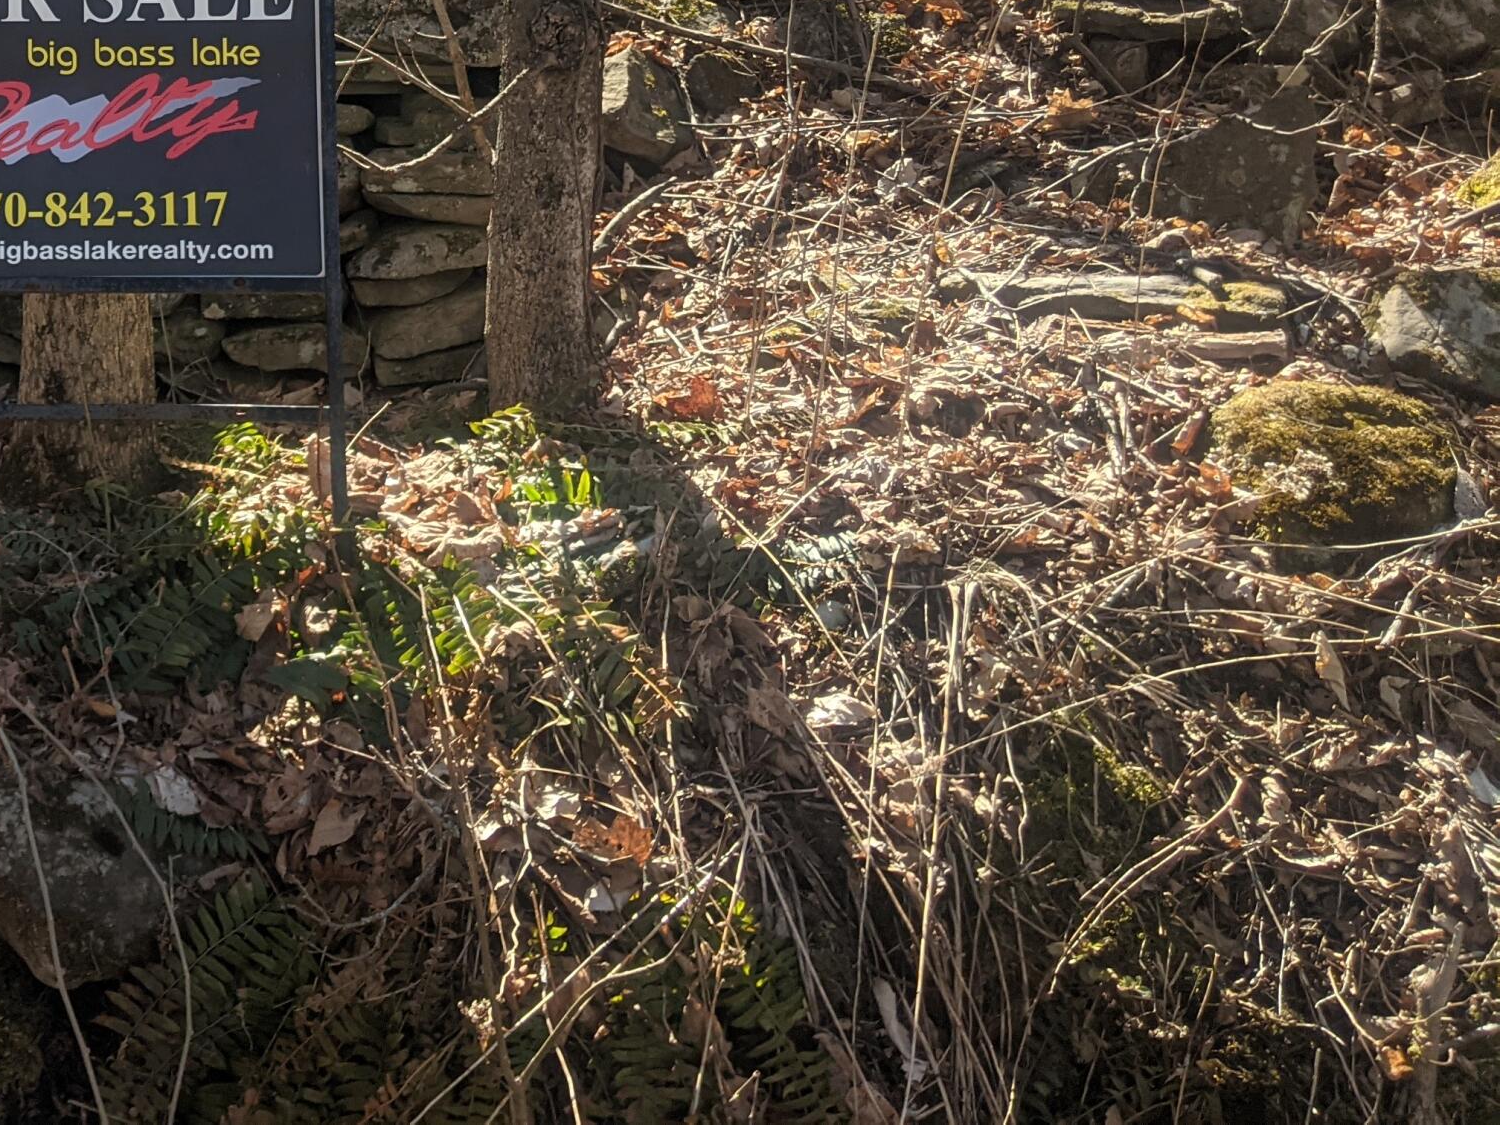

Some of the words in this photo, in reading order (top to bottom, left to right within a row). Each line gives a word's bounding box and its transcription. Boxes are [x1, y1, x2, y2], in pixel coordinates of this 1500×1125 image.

[26, 39, 78, 75] big
[94, 39, 175, 67] bass
[191, 38, 261, 66] lake
